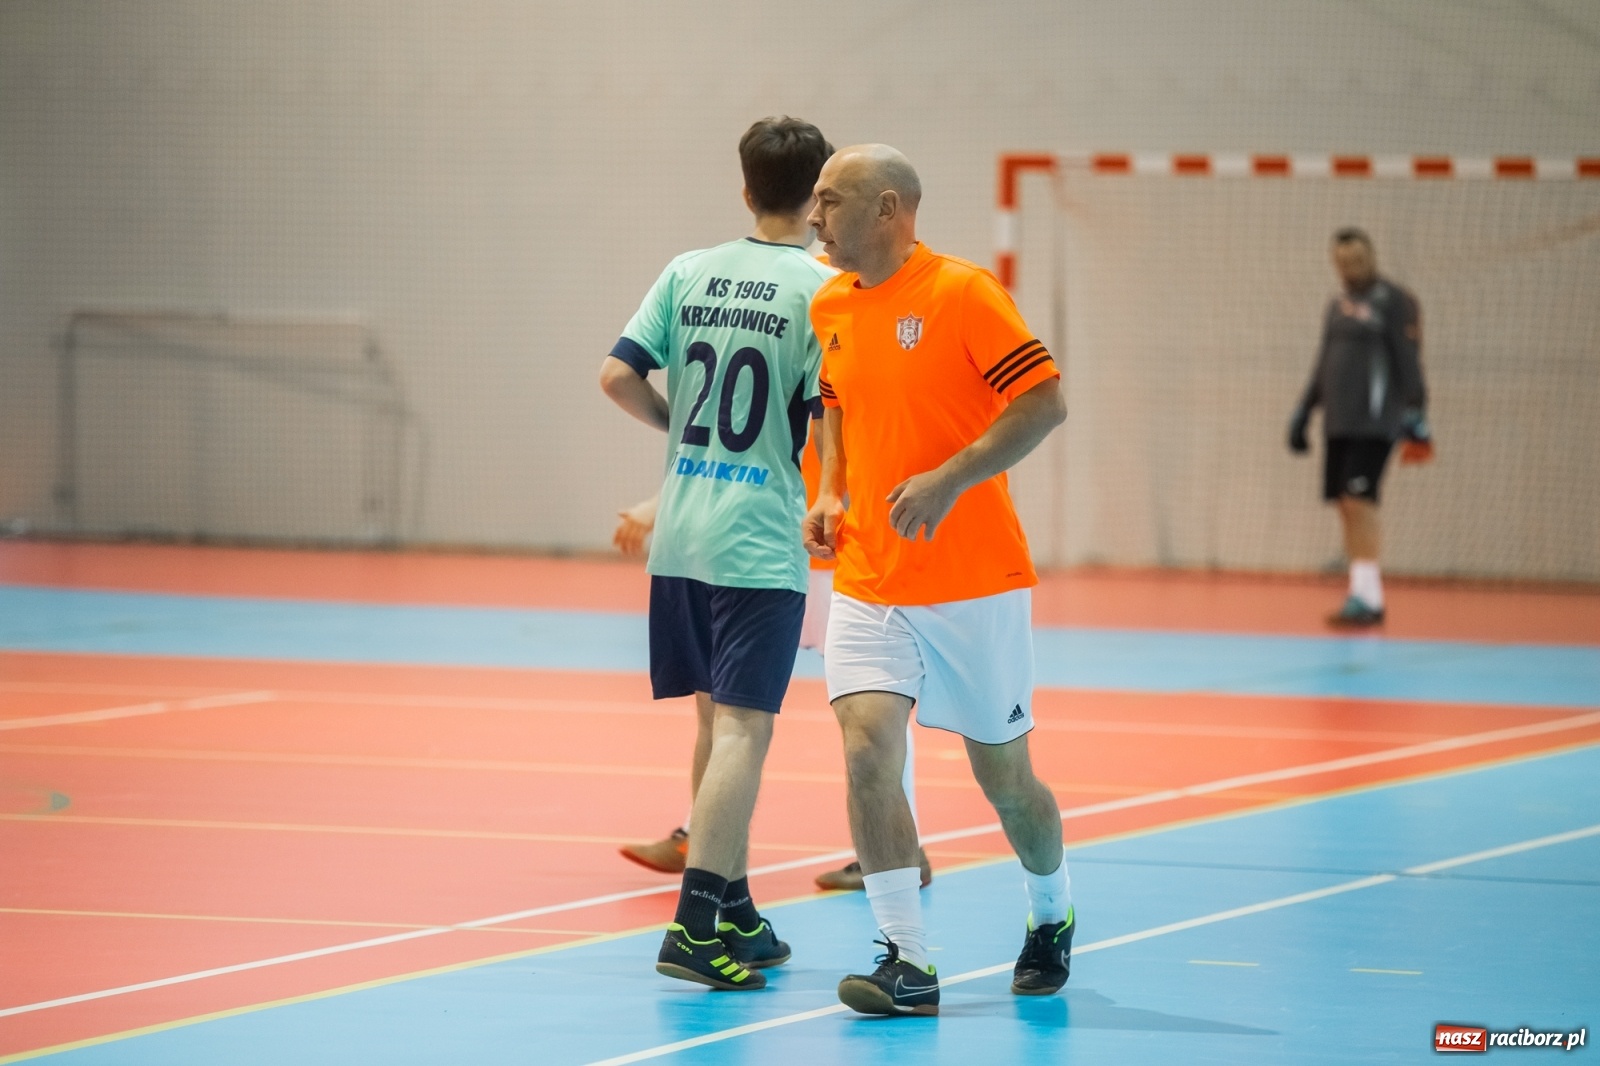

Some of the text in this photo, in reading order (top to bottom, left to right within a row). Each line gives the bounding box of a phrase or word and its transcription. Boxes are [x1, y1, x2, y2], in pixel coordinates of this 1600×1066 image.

[706, 277, 779, 301] KS 1905
[681, 305, 789, 339] KRZANOWICE
[680, 341, 769, 453] 20
[676, 457, 769, 485] DAIKIN
[690, 889, 721, 905] adida
[676, 942, 693, 955] COPA
